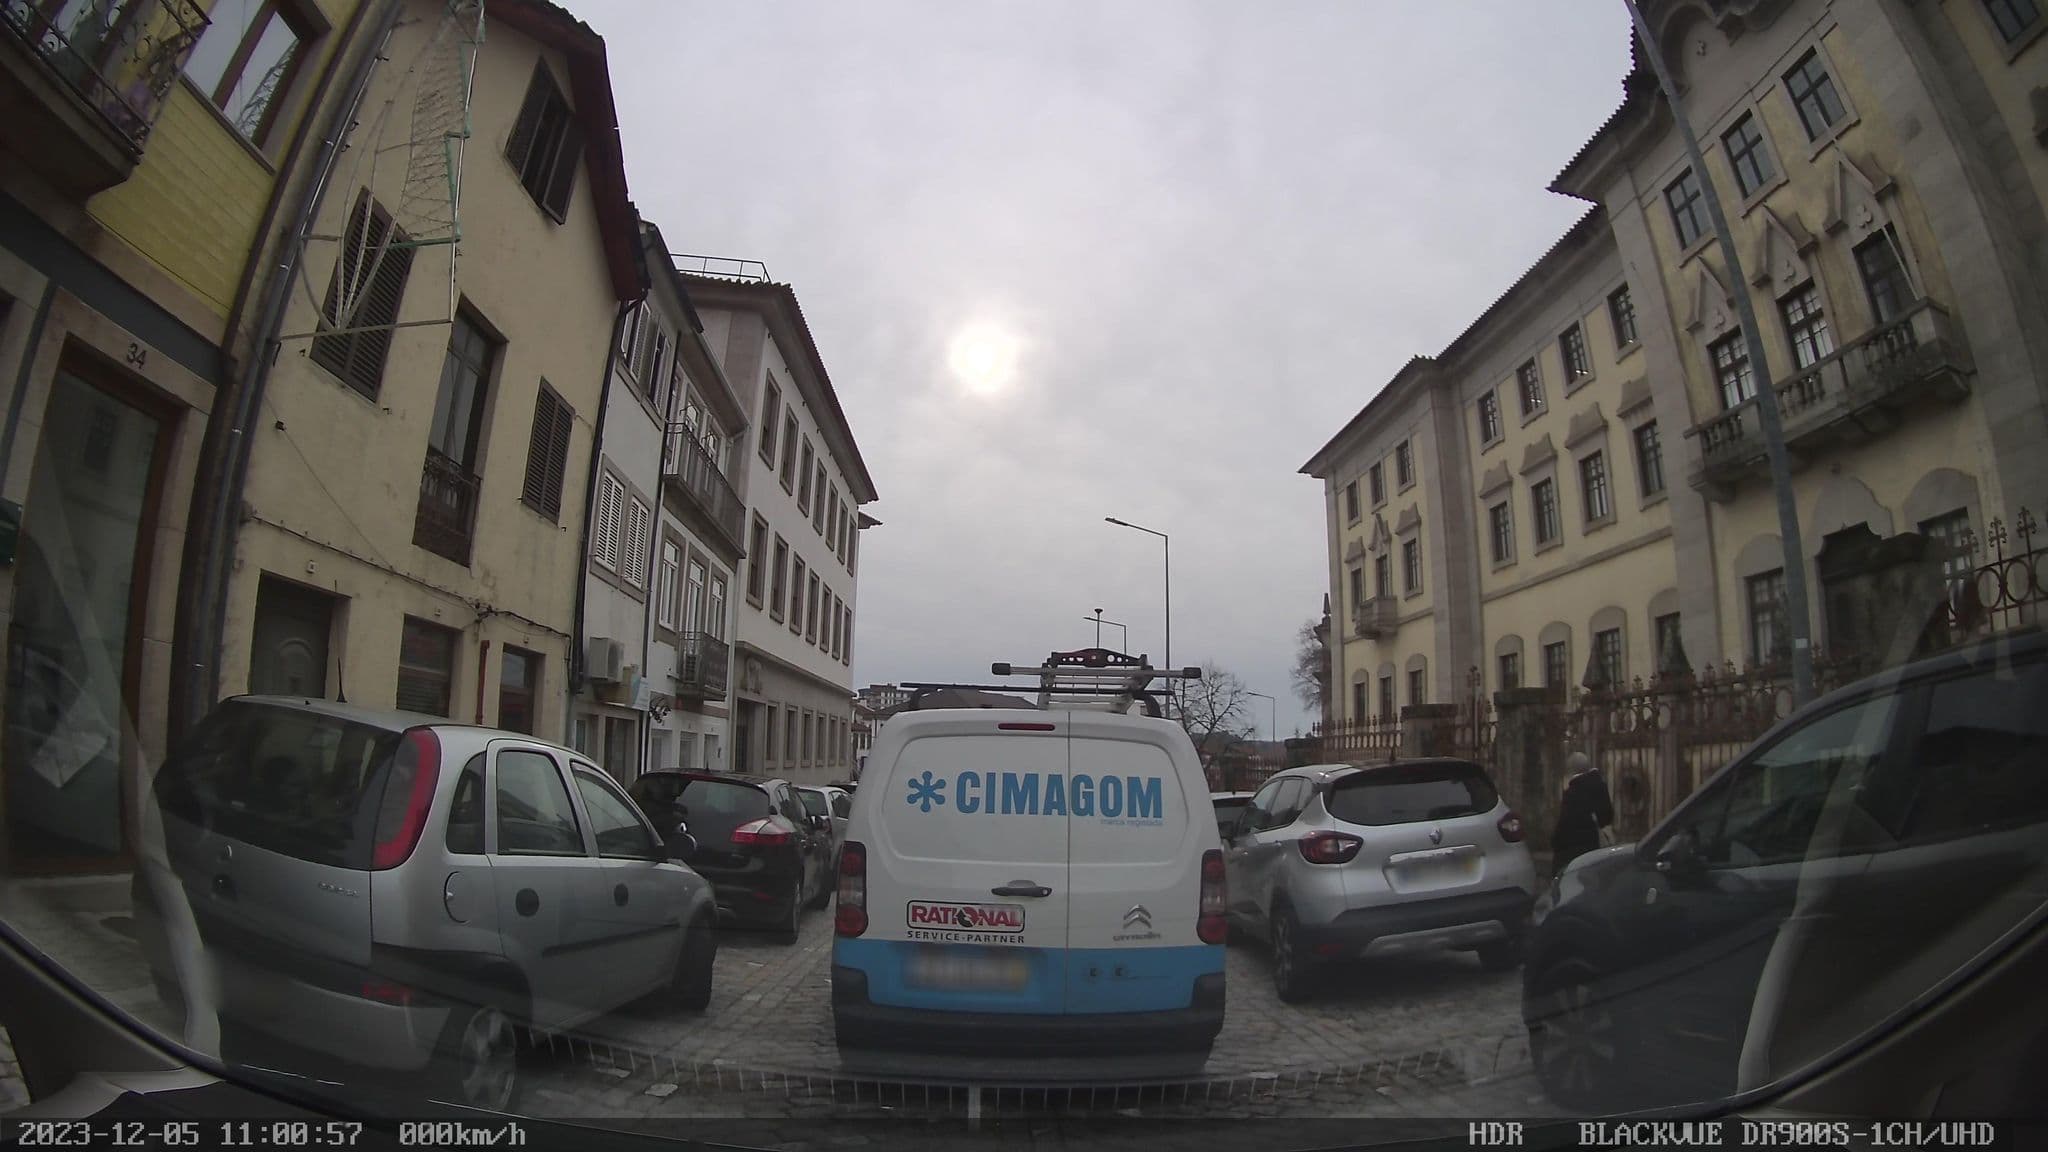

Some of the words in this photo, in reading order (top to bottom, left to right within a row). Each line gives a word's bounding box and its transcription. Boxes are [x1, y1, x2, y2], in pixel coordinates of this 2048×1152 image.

[127, 342, 146, 369] 34
[956, 771, 1162, 818] CIMAGOM
[911, 905, 1022, 928] RATIONAL
